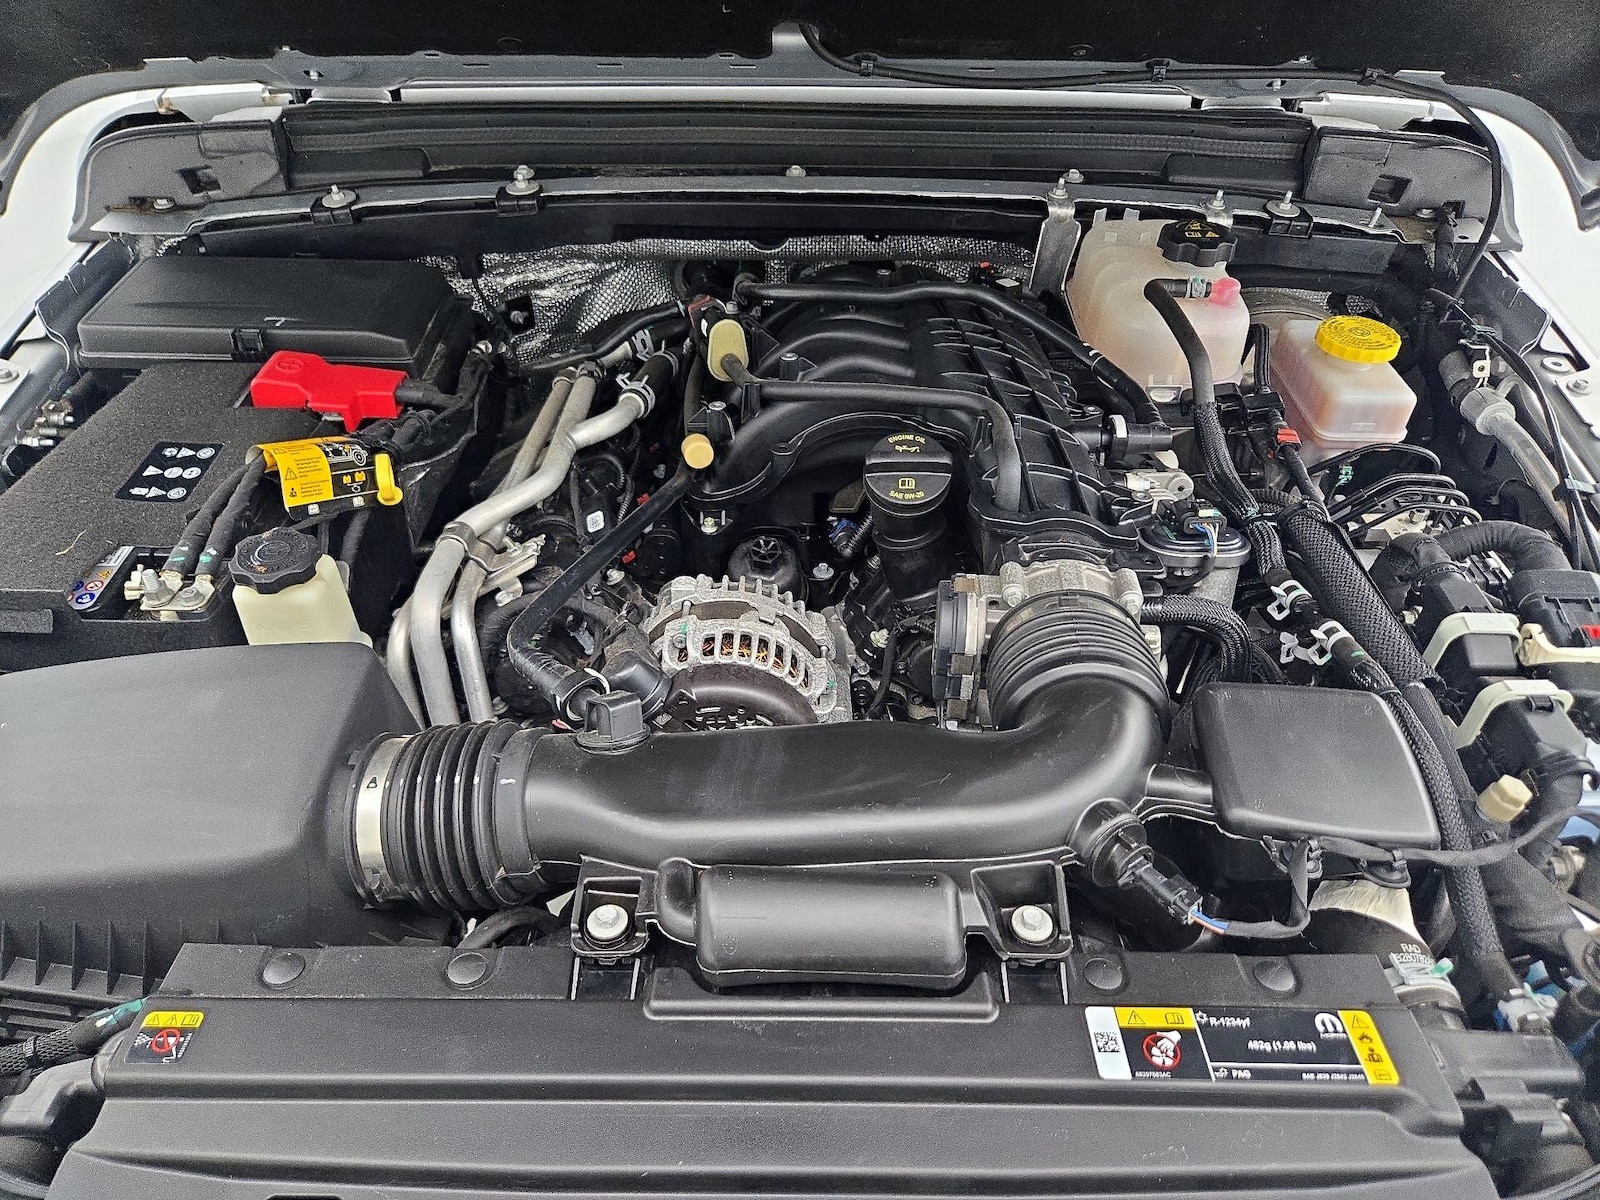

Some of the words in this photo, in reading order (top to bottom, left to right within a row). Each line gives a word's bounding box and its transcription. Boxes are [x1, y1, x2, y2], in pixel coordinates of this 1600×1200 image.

[888, 434, 914, 444] ENGINE
[915, 435, 926, 444] OIL
[889, 490, 904, 499] SAE
[904, 491, 925, 499] 0W-20
[1400, 943, 1421, 953] RAD
[1297, 1040, 1317, 1053] lbs)
[1231, 1069, 1251, 1079] PAG
